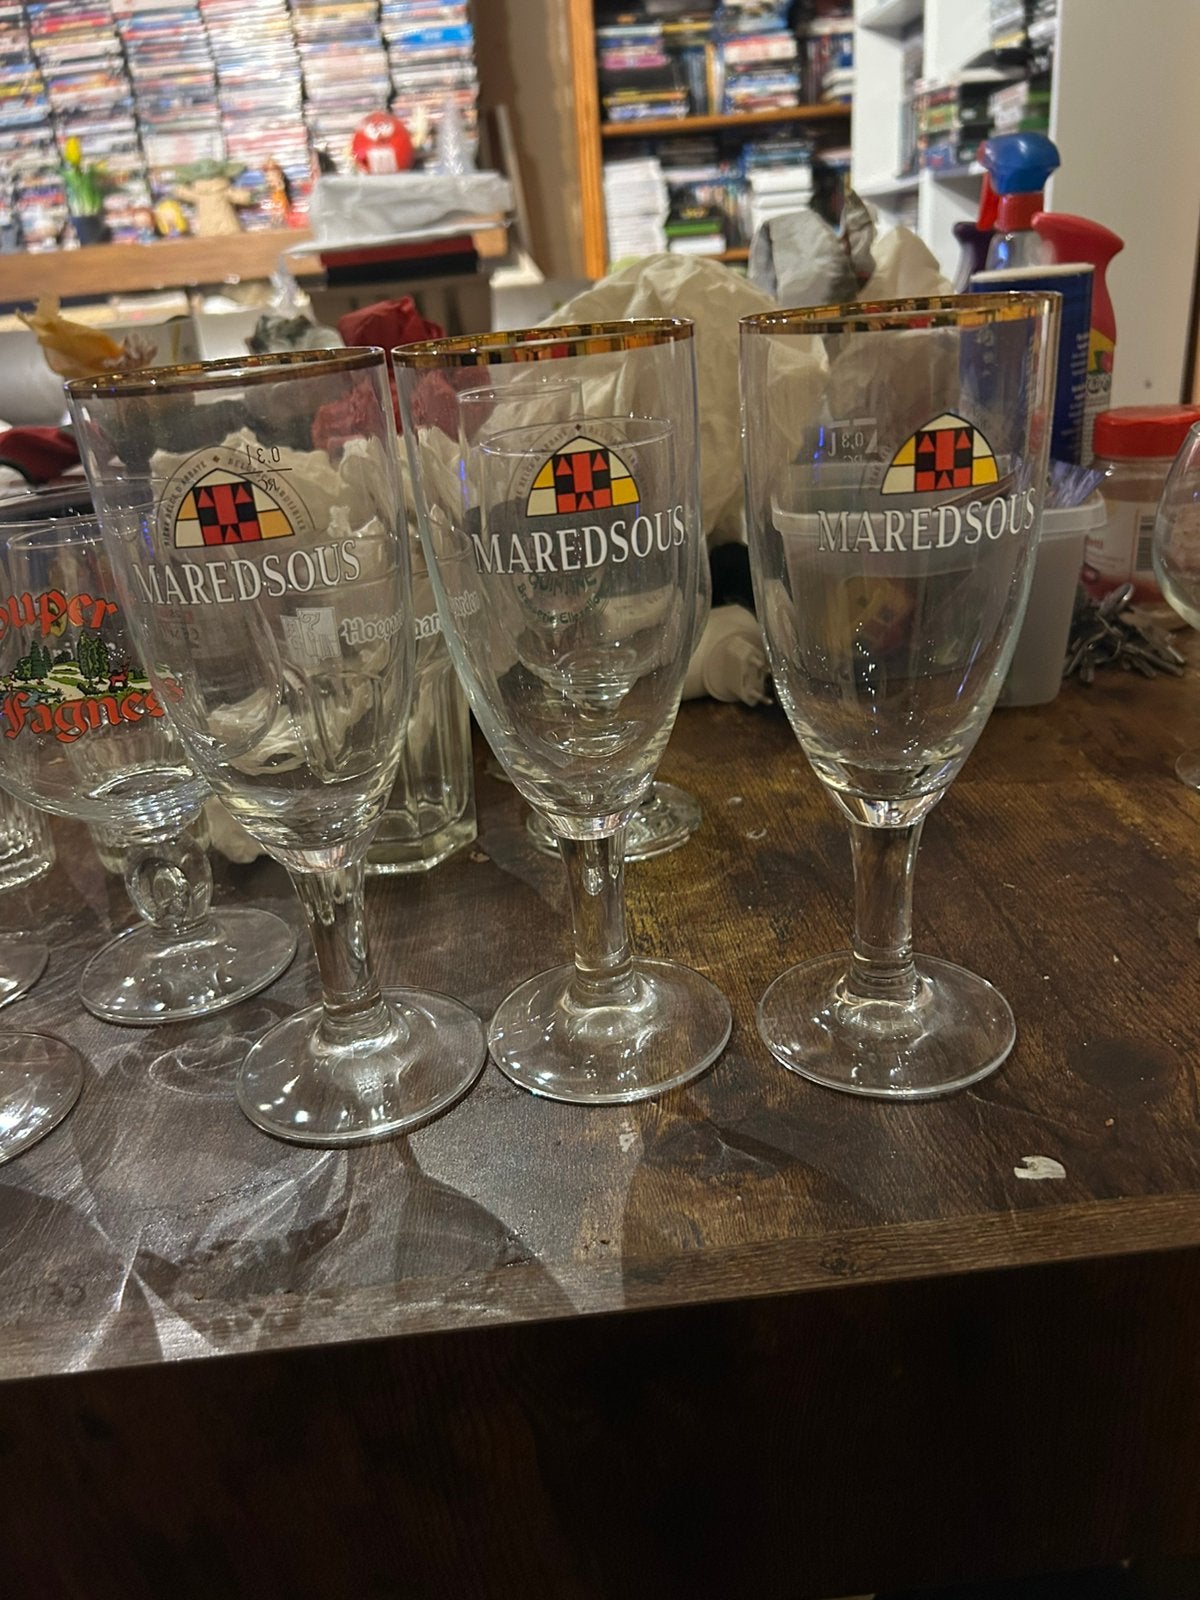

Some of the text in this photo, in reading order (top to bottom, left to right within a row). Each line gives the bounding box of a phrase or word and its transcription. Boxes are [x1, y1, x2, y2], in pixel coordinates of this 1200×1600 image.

[471, 505, 686, 575] MAREDSOUS
[816, 487, 1037, 553] MAREDSOUS
[133, 539, 362, 606] MAREDSOUS
